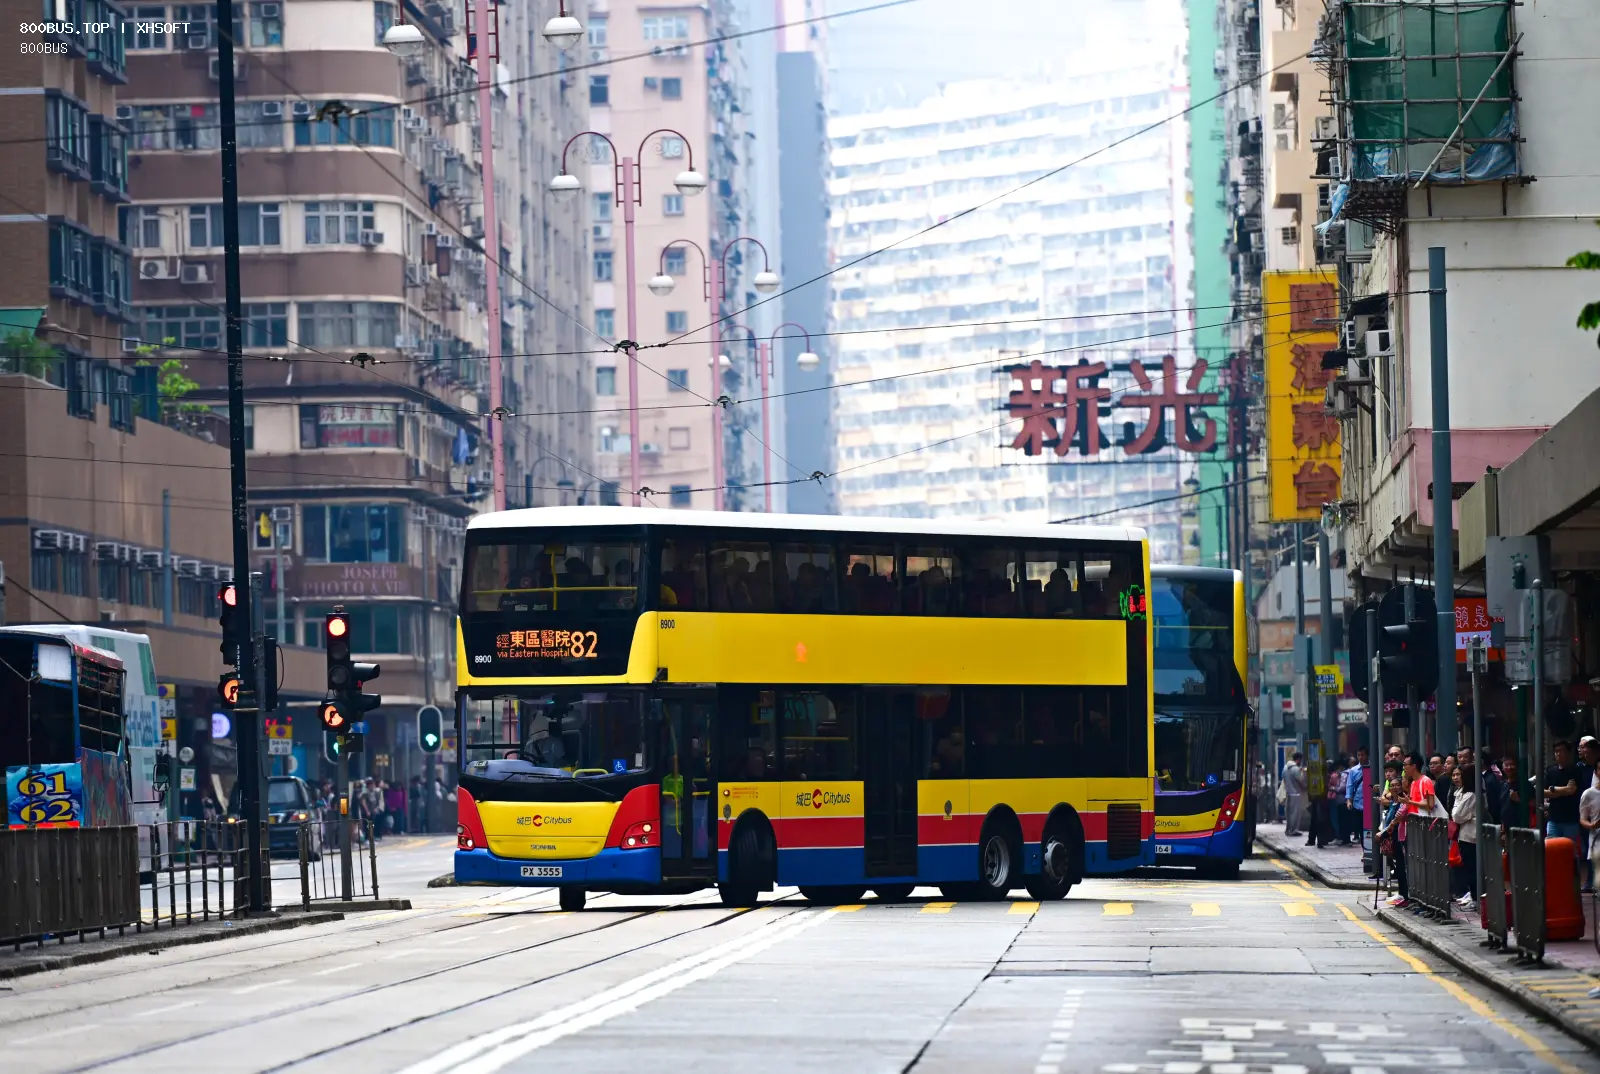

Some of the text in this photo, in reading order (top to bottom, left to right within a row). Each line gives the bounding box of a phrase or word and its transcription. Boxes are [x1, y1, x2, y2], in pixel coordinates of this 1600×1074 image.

[1008, 355, 1219, 457] 新光
[341, 565, 397, 579] JOSEPH
[303, 581, 364, 595] PHOTO
[660, 619, 676, 629] 8900
[496, 630, 598, 658] 經東區醫院 82
[474, 655, 492, 663] 8900
[509, 649, 540, 658] Eastern
[541, 649, 570, 659] Hospital
[17, 771, 72, 797] 61
[796, 791, 851, 807] 城巴 Citybus
[20, 798, 74, 822] 62
[517, 816, 572, 825] 城巴 Citybus
[522, 867, 560, 876] PX 3555
